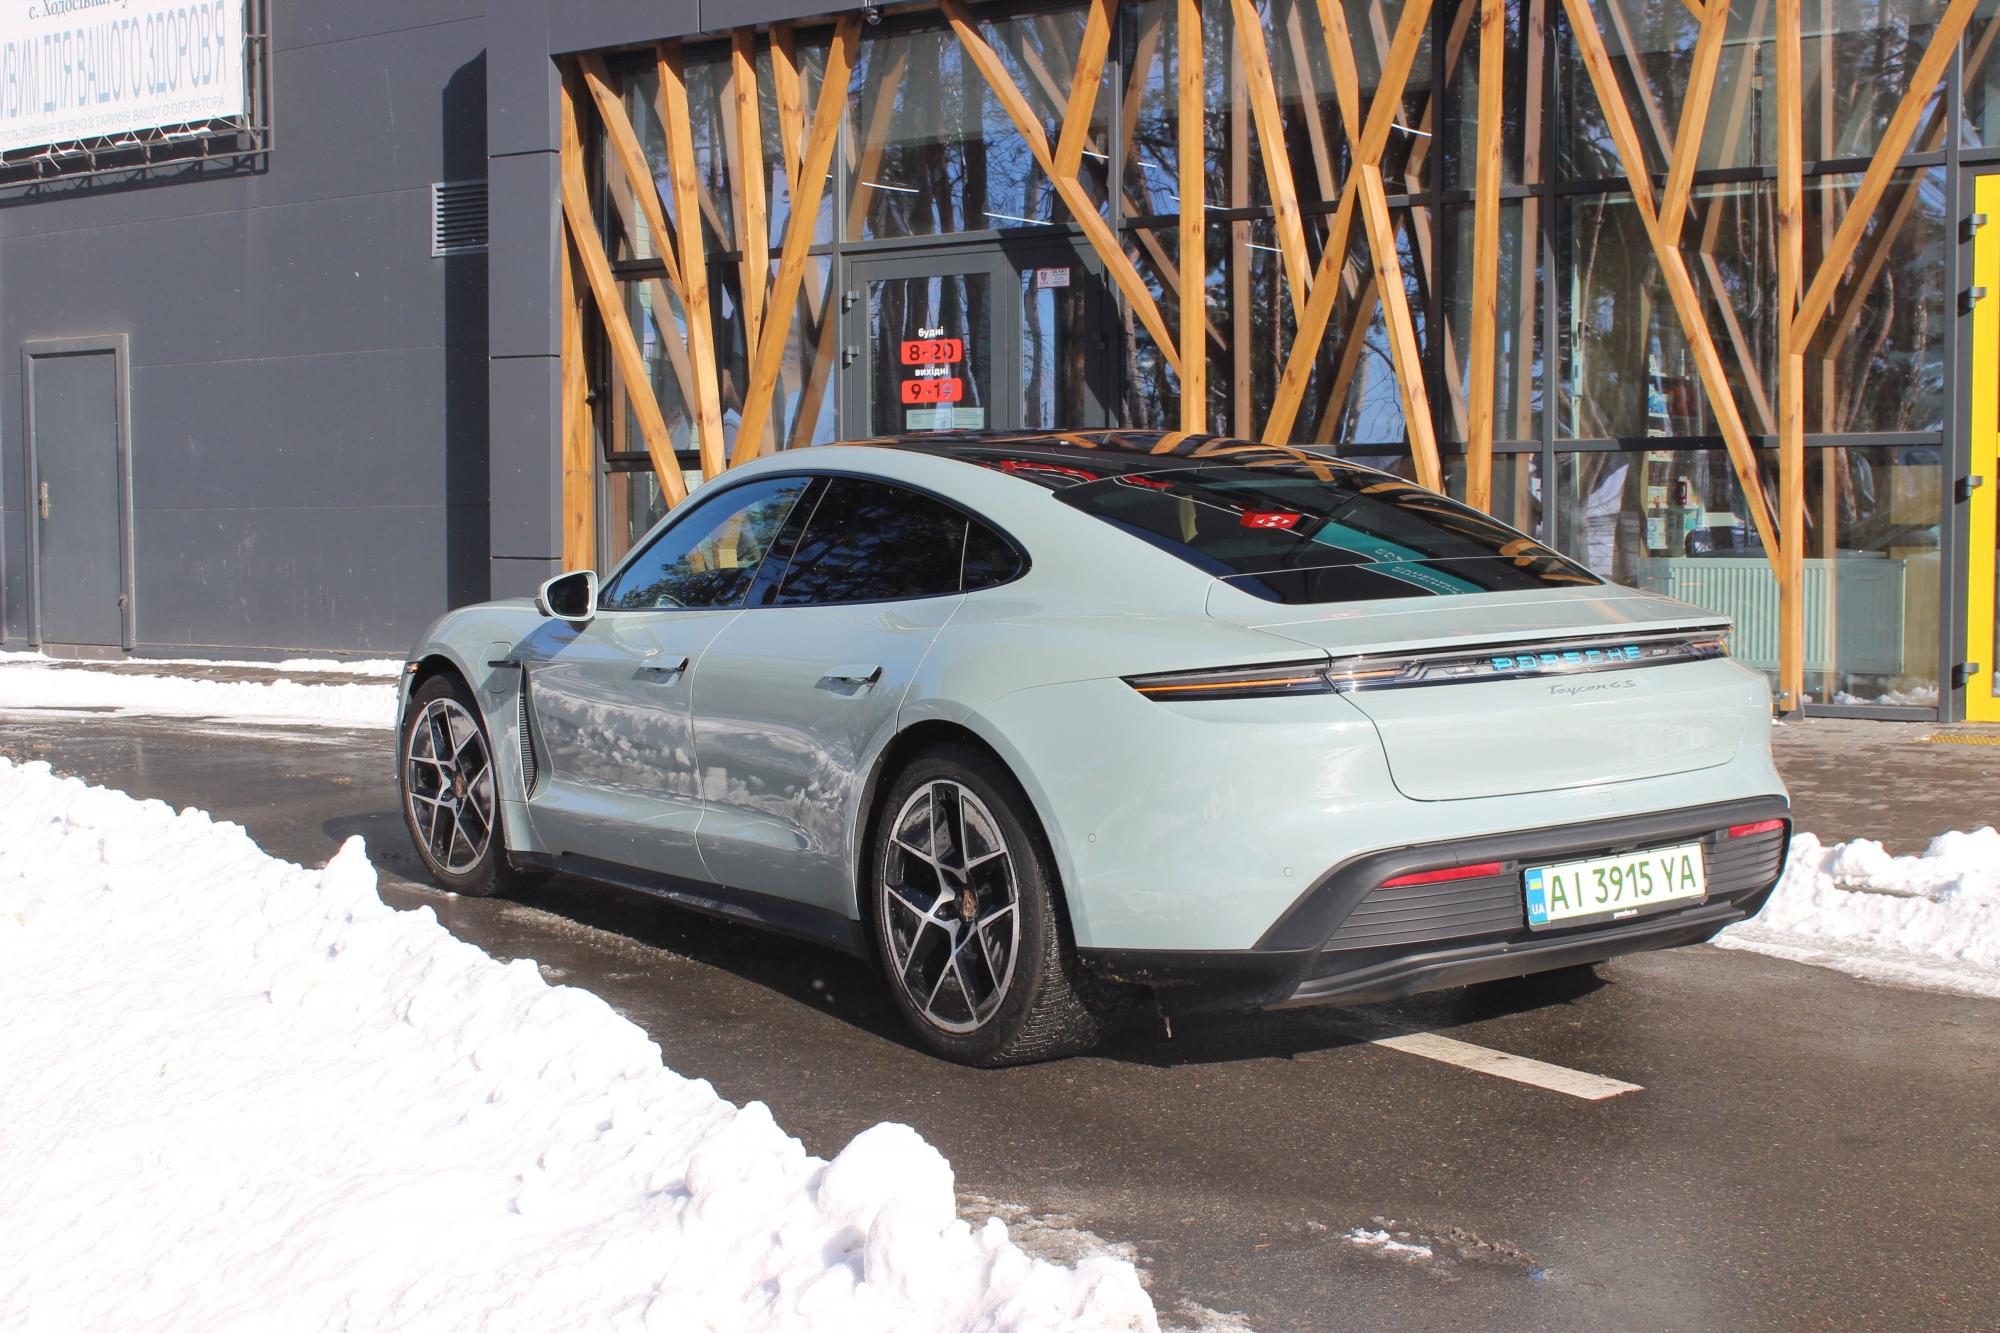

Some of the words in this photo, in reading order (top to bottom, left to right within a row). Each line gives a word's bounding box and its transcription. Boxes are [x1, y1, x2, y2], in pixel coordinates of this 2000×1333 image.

[29, 6, 39, 20] с.
[43, 30, 73, 119] ДЛЯ
[77, 17, 142, 107] ВАШОГО
[146, 0, 227, 97] ЗДОРОВ'Я
[133, 103, 169, 122] ВАШОГО
[171, 95, 226, 116] ОПЕРАТОРА
[918, 326, 944, 339] будні
[909, 342, 955, 362] 8-20
[915, 366, 949, 376] вихідні
[1490, 645, 1642, 671] PORSCHE
[1547, 682, 1608, 697] Taycan
[1551, 872, 1583, 912] AI
[1592, 860, 1653, 904] 3915
[1661, 855, 1696, 893] YA
[1532, 904, 1546, 915] UA
